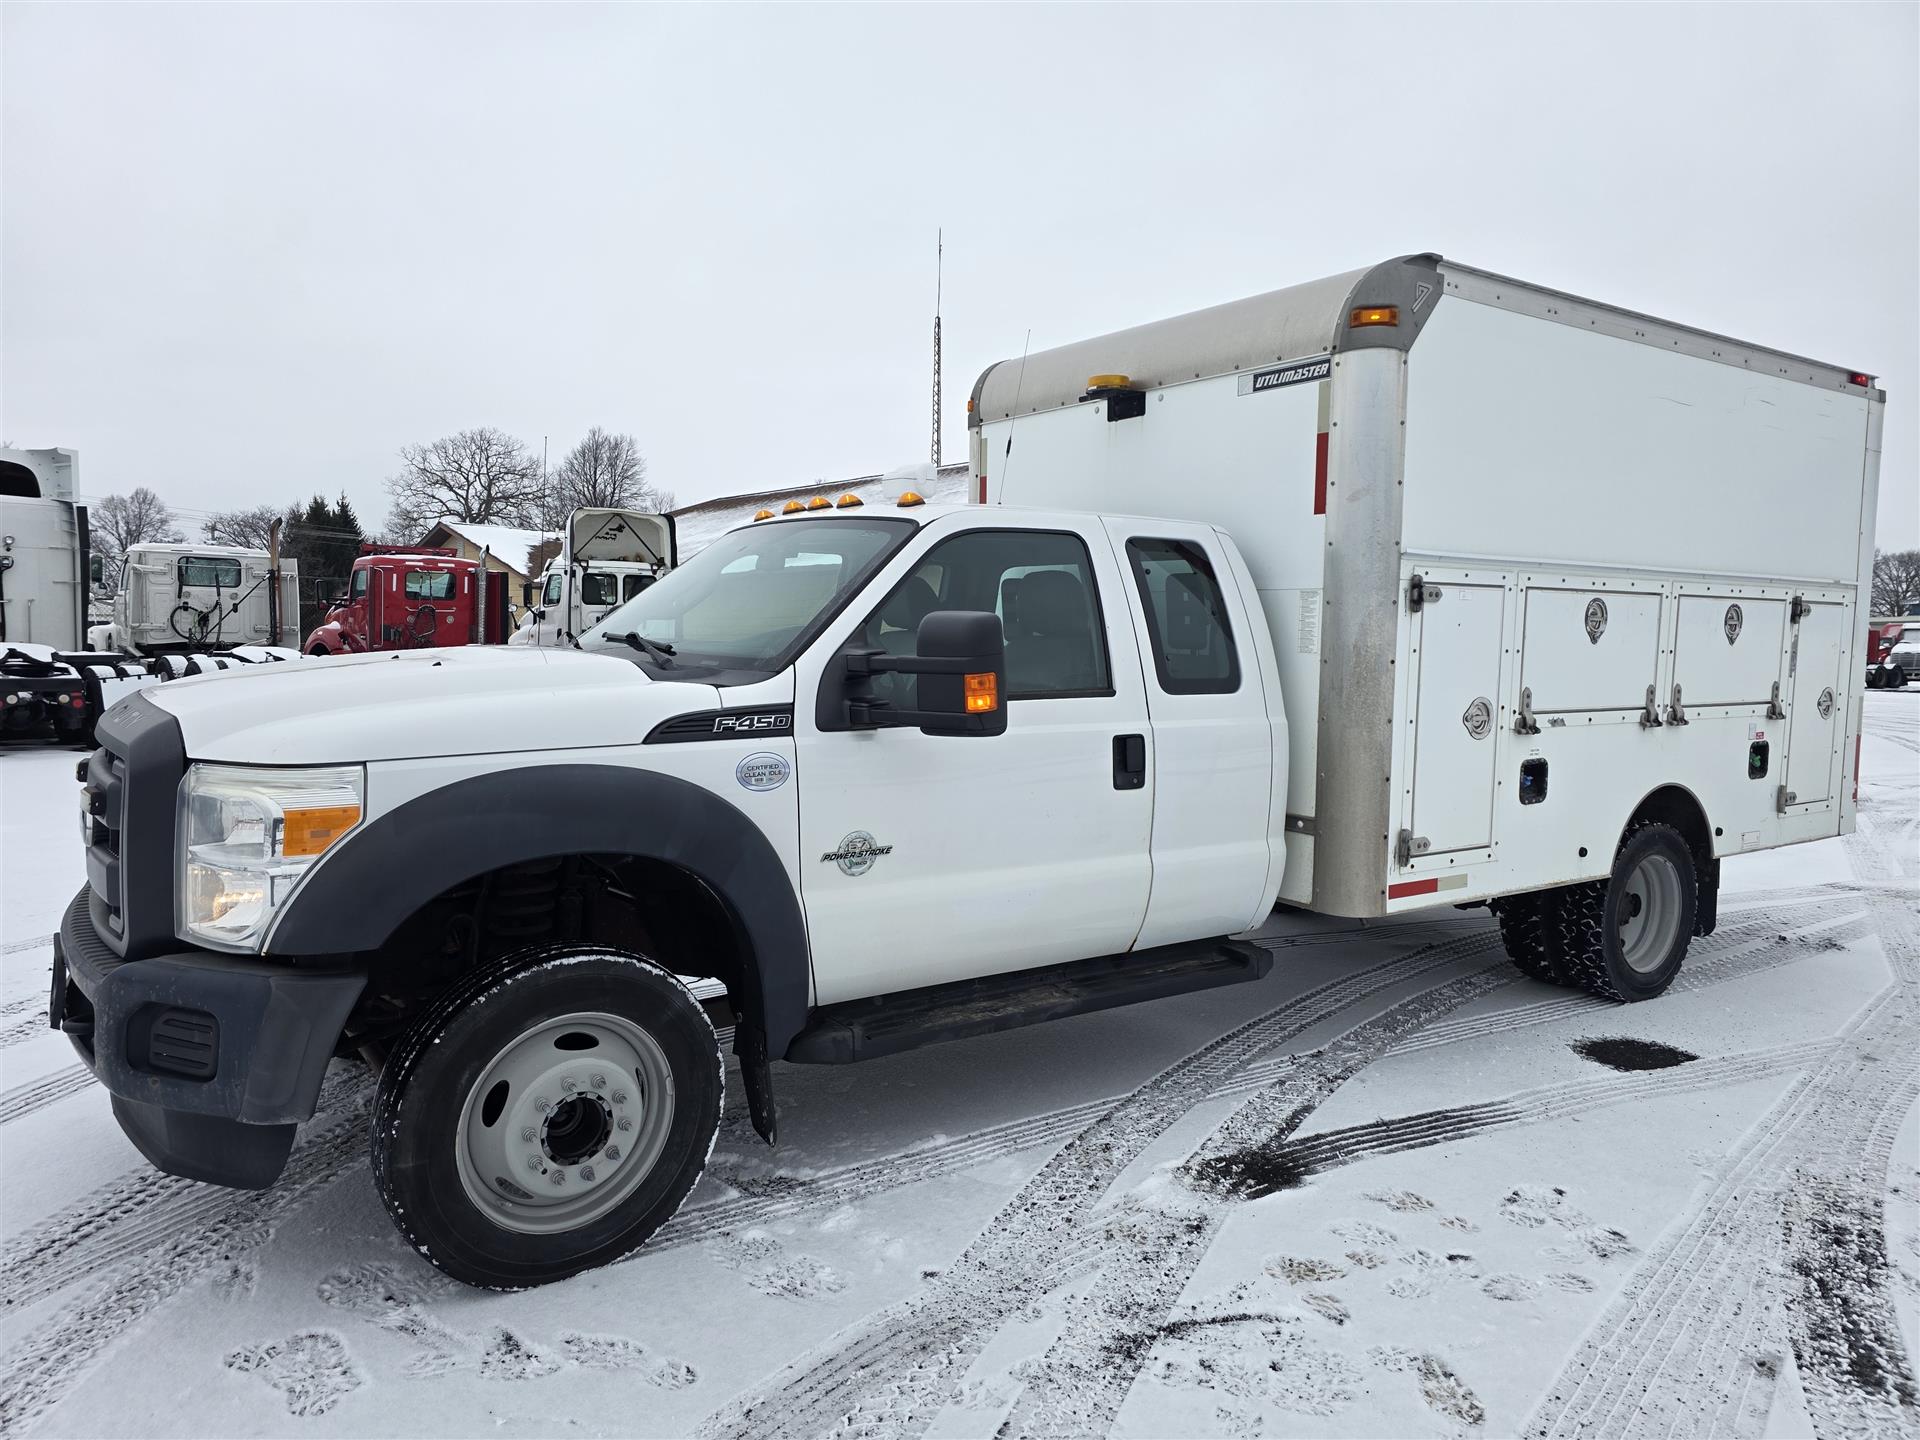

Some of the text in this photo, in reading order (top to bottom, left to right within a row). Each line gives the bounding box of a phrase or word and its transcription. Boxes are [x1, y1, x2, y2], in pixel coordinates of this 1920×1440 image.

[1255, 363, 1330, 388] UTILIMASTER
[712, 714, 791, 733] F-450
[746, 763, 780, 772] CERTIFIED
[821, 845, 893, 862] POWER STROKE
